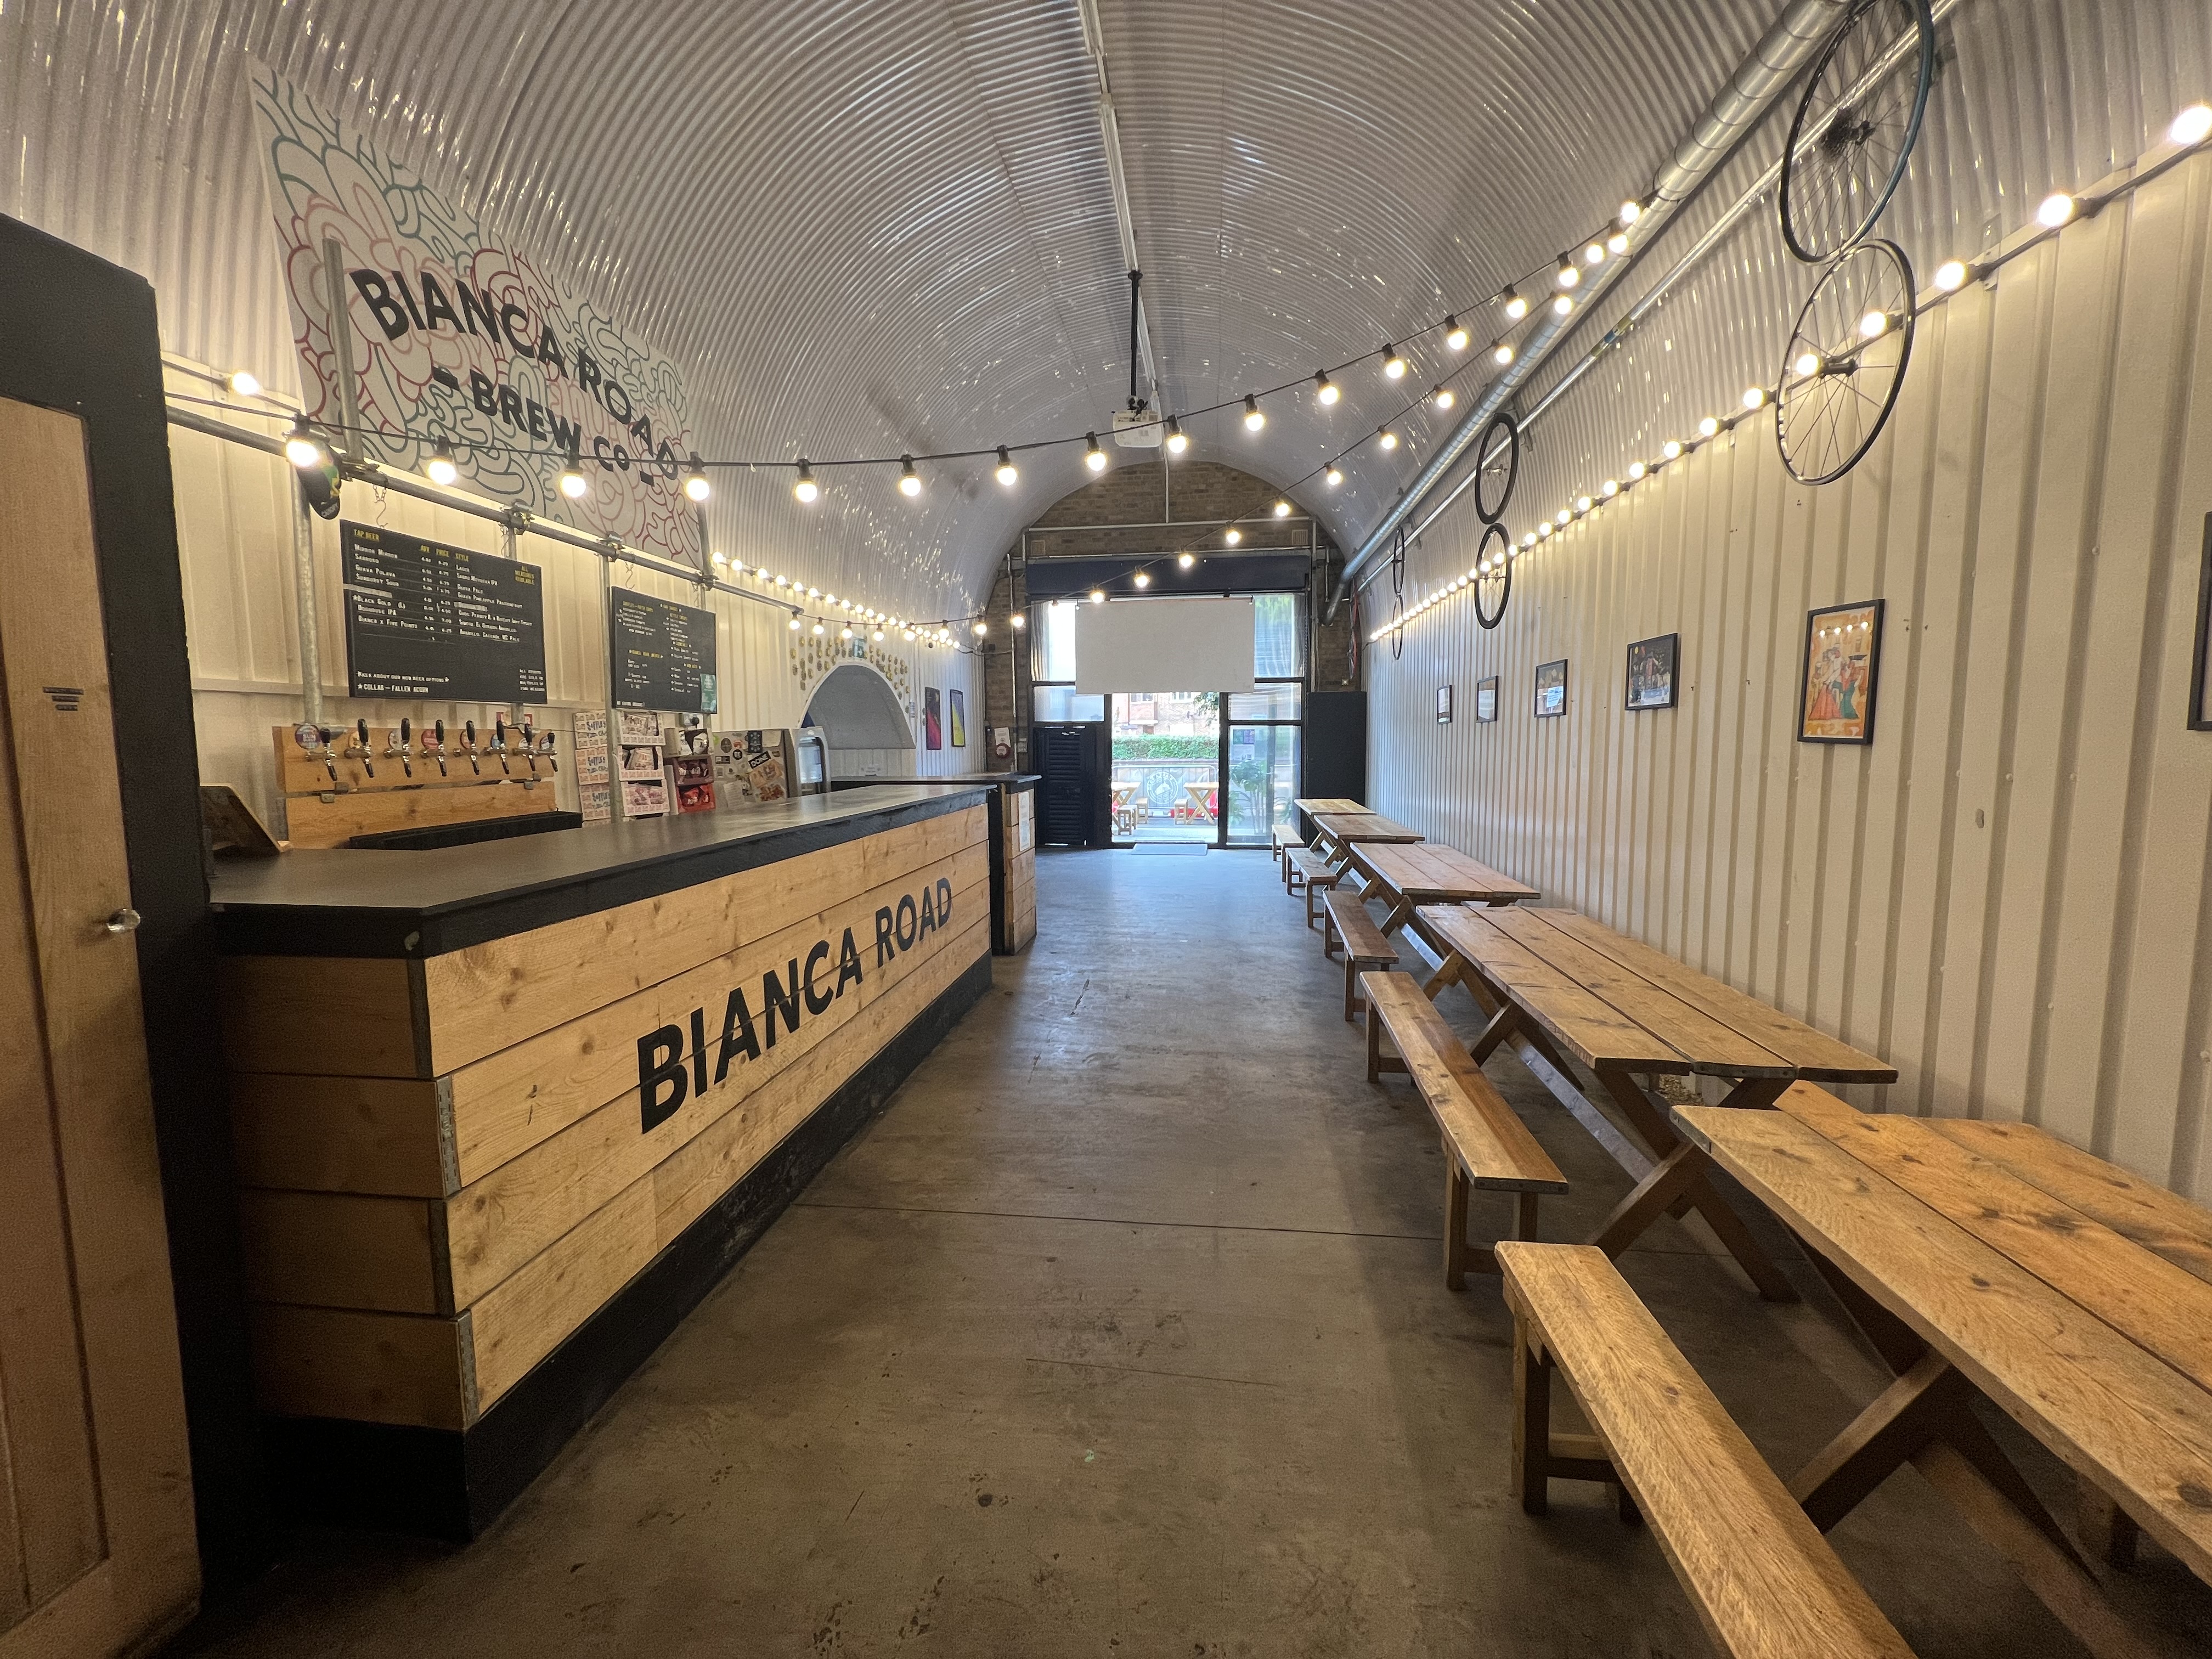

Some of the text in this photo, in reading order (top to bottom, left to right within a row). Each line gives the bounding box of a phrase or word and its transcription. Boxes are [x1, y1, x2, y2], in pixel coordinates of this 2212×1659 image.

[349, 269, 679, 481] BIANCA ROAD
[470, 369, 582, 457] BREW
[354, 529, 380, 541] TAP BEER
[436, 548, 450, 557] PRICE
[455, 552, 469, 562] STYLE
[355, 564, 396, 577] GUAVA POLAVA
[358, 595, 375, 603] BLACK
[377, 598, 391, 606] GOLD
[358, 615, 377, 624] BIANCA
[637, 877, 952, 1134] BIANCA ROAD
